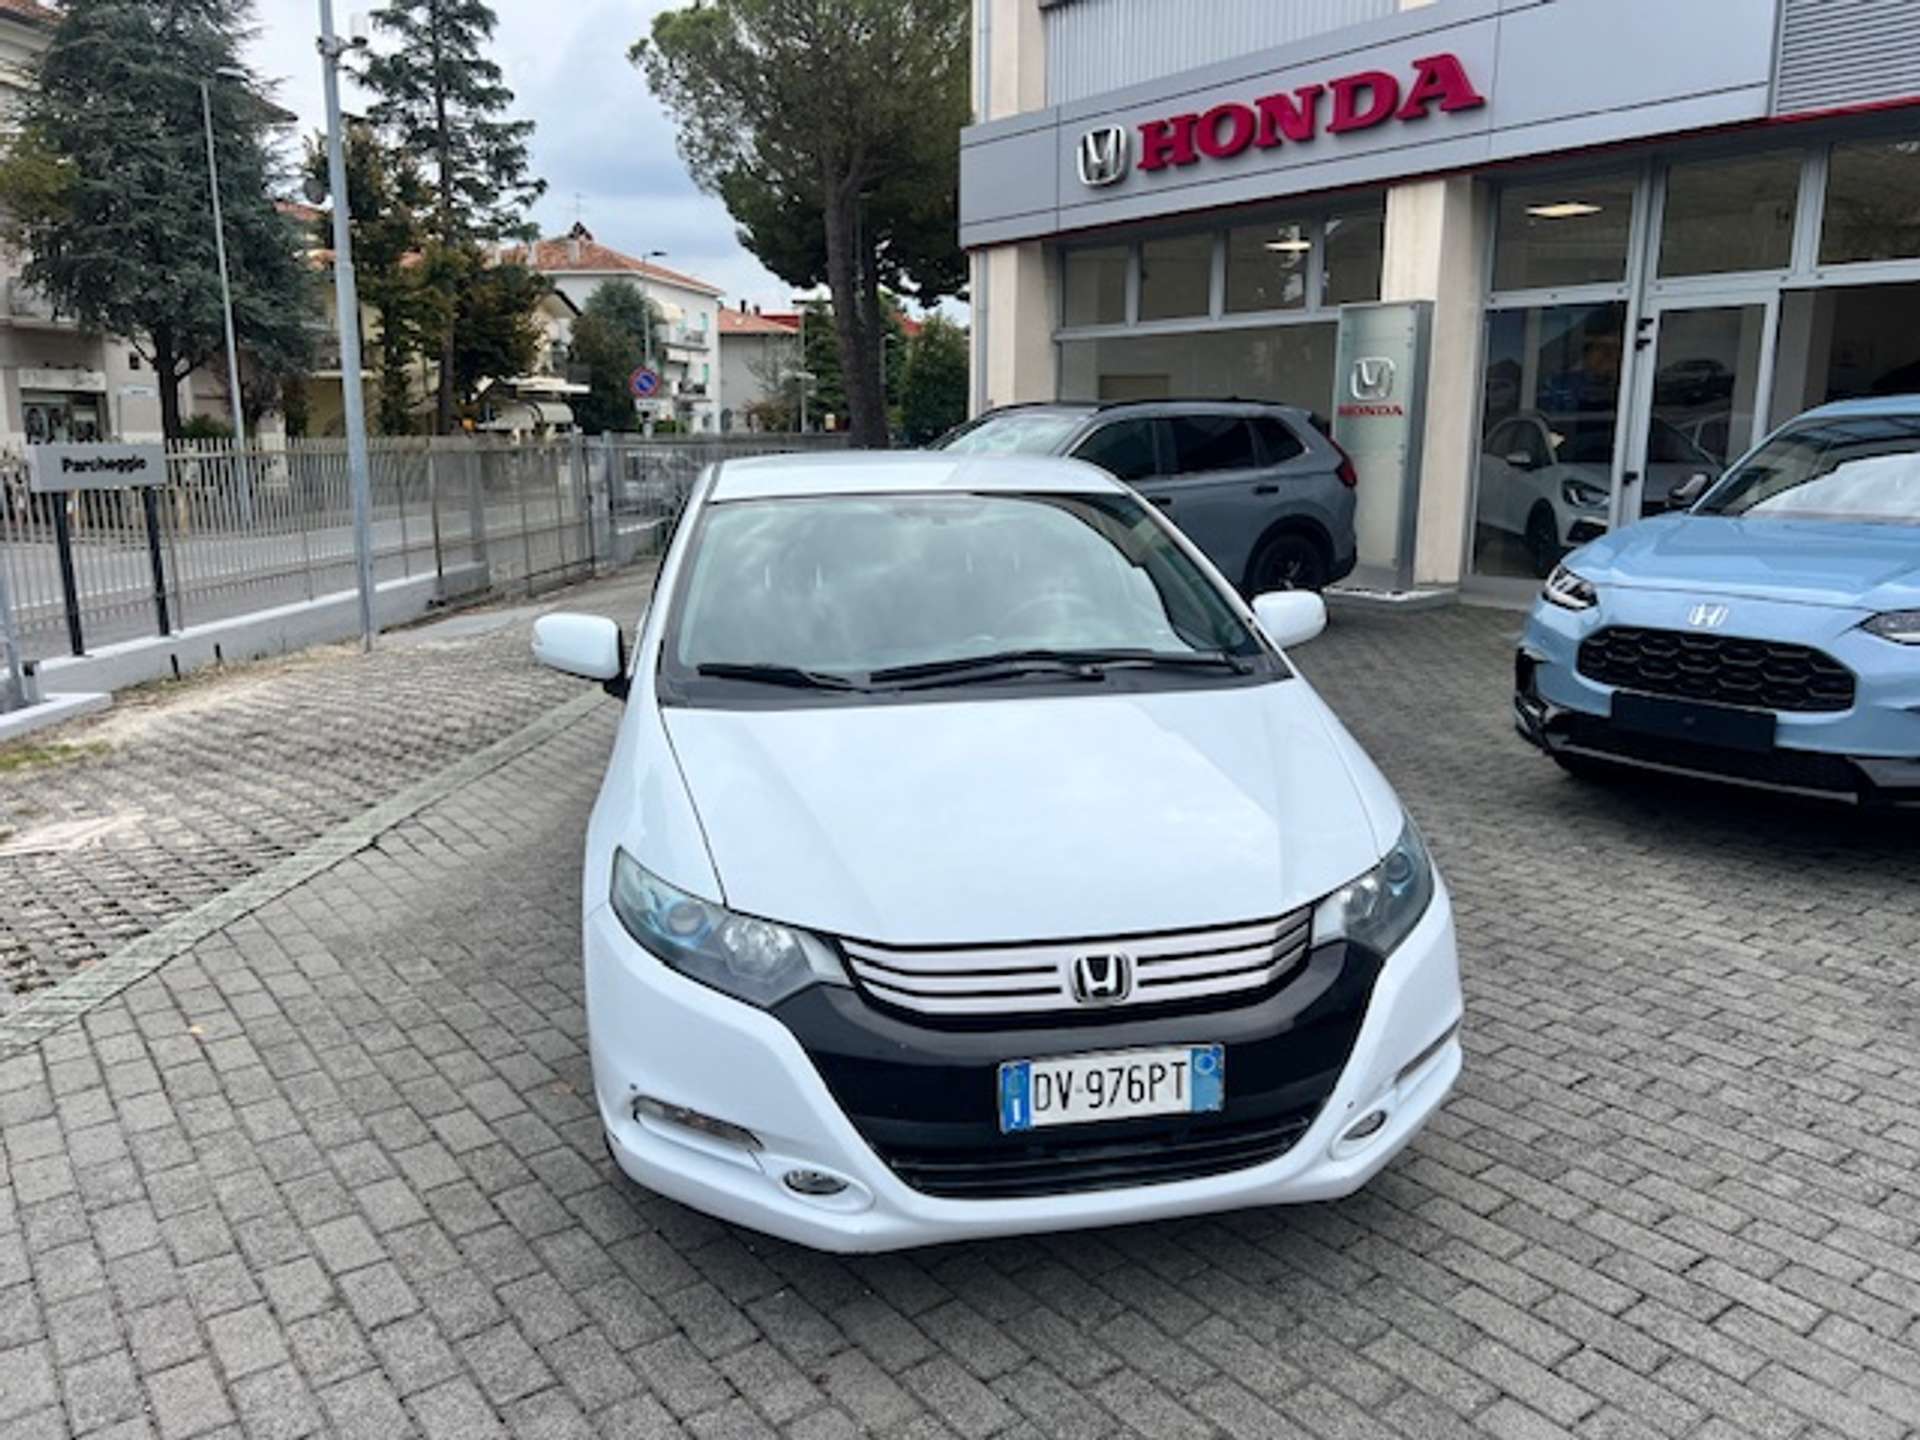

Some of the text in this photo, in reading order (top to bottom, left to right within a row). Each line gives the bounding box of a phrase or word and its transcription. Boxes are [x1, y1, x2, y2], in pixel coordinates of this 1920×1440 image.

[1137, 53, 1486, 171] HONDA
[1337, 404, 1403, 417] HONDA
[61, 454, 147, 474] Parcheggio
[1034, 1070, 1073, 1112] DV
[1085, 1061, 1188, 1109] 976PT
